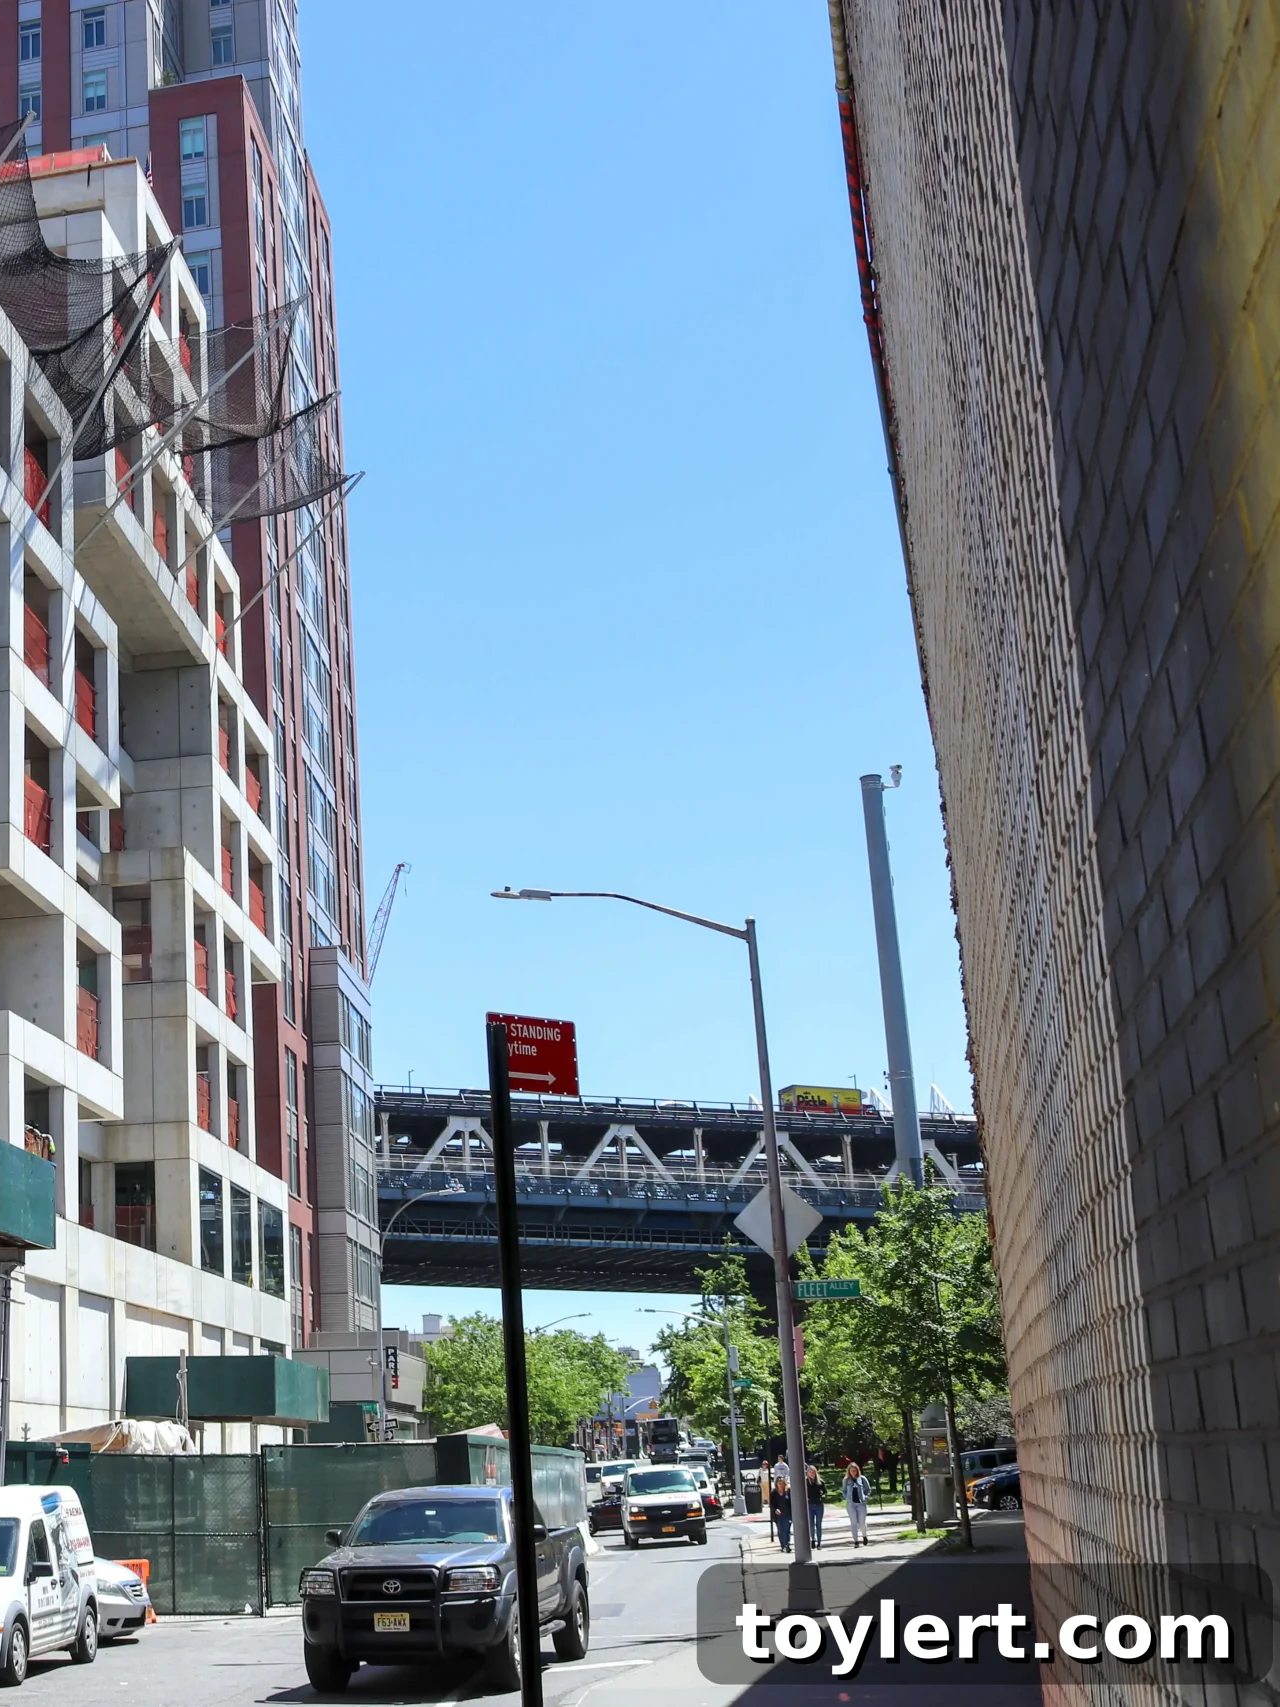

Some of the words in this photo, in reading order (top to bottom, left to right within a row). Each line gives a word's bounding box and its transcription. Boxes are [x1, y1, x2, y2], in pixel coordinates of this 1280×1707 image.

[510, 1023, 561, 1041] STANDING
[507, 1041, 538, 1057] ytime
[797, 1282, 828, 1297] FLEET
[829, 1281, 854, 1290] ALLEY
